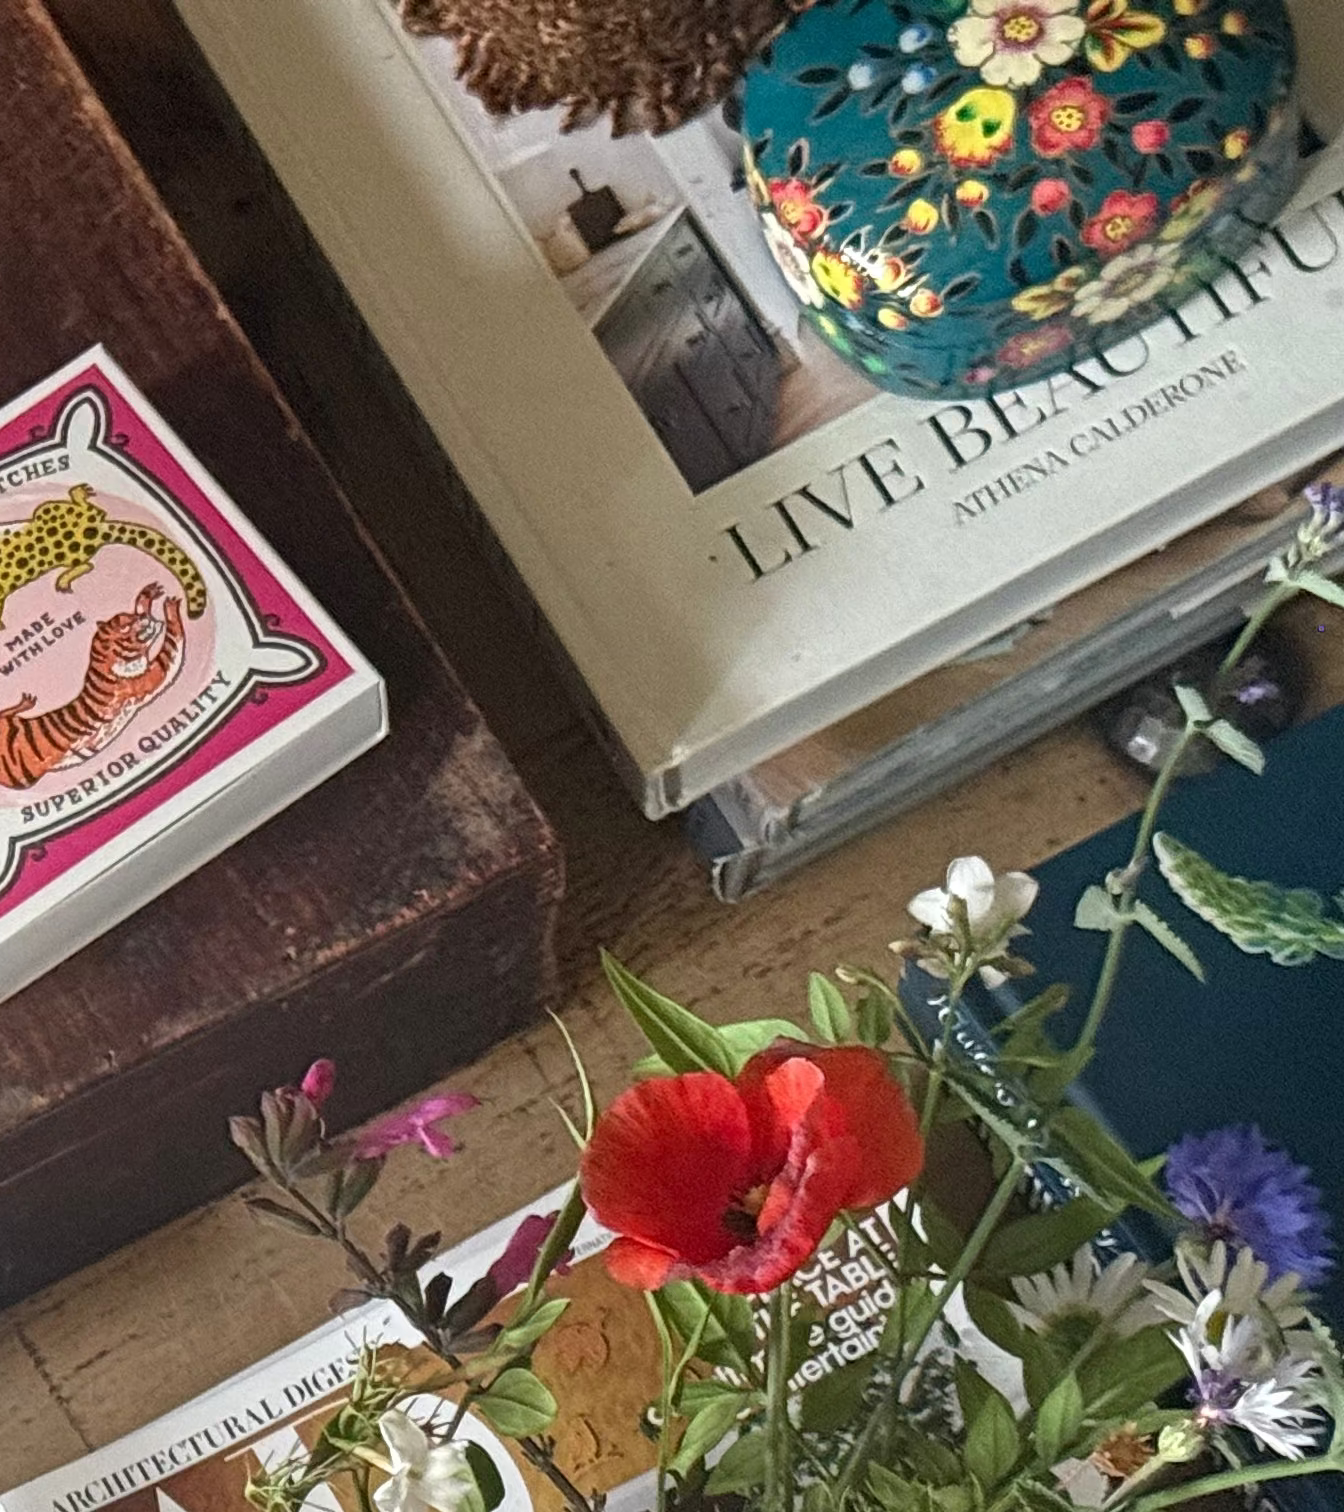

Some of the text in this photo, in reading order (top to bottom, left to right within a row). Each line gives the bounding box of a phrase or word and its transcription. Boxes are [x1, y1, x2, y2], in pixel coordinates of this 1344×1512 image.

[951, 349, 1248, 527] ATHENA CALDERONE
[721, 437, 925, 584] LIVE
[4, 611, 56, 653] MADE
[43, 611, 87, 647] LOVE
[20, 669, 232, 825] SUPERIOR QUALITY
[828, 1279, 896, 1338] guid
[282, 1350, 361, 1409] DIGES
